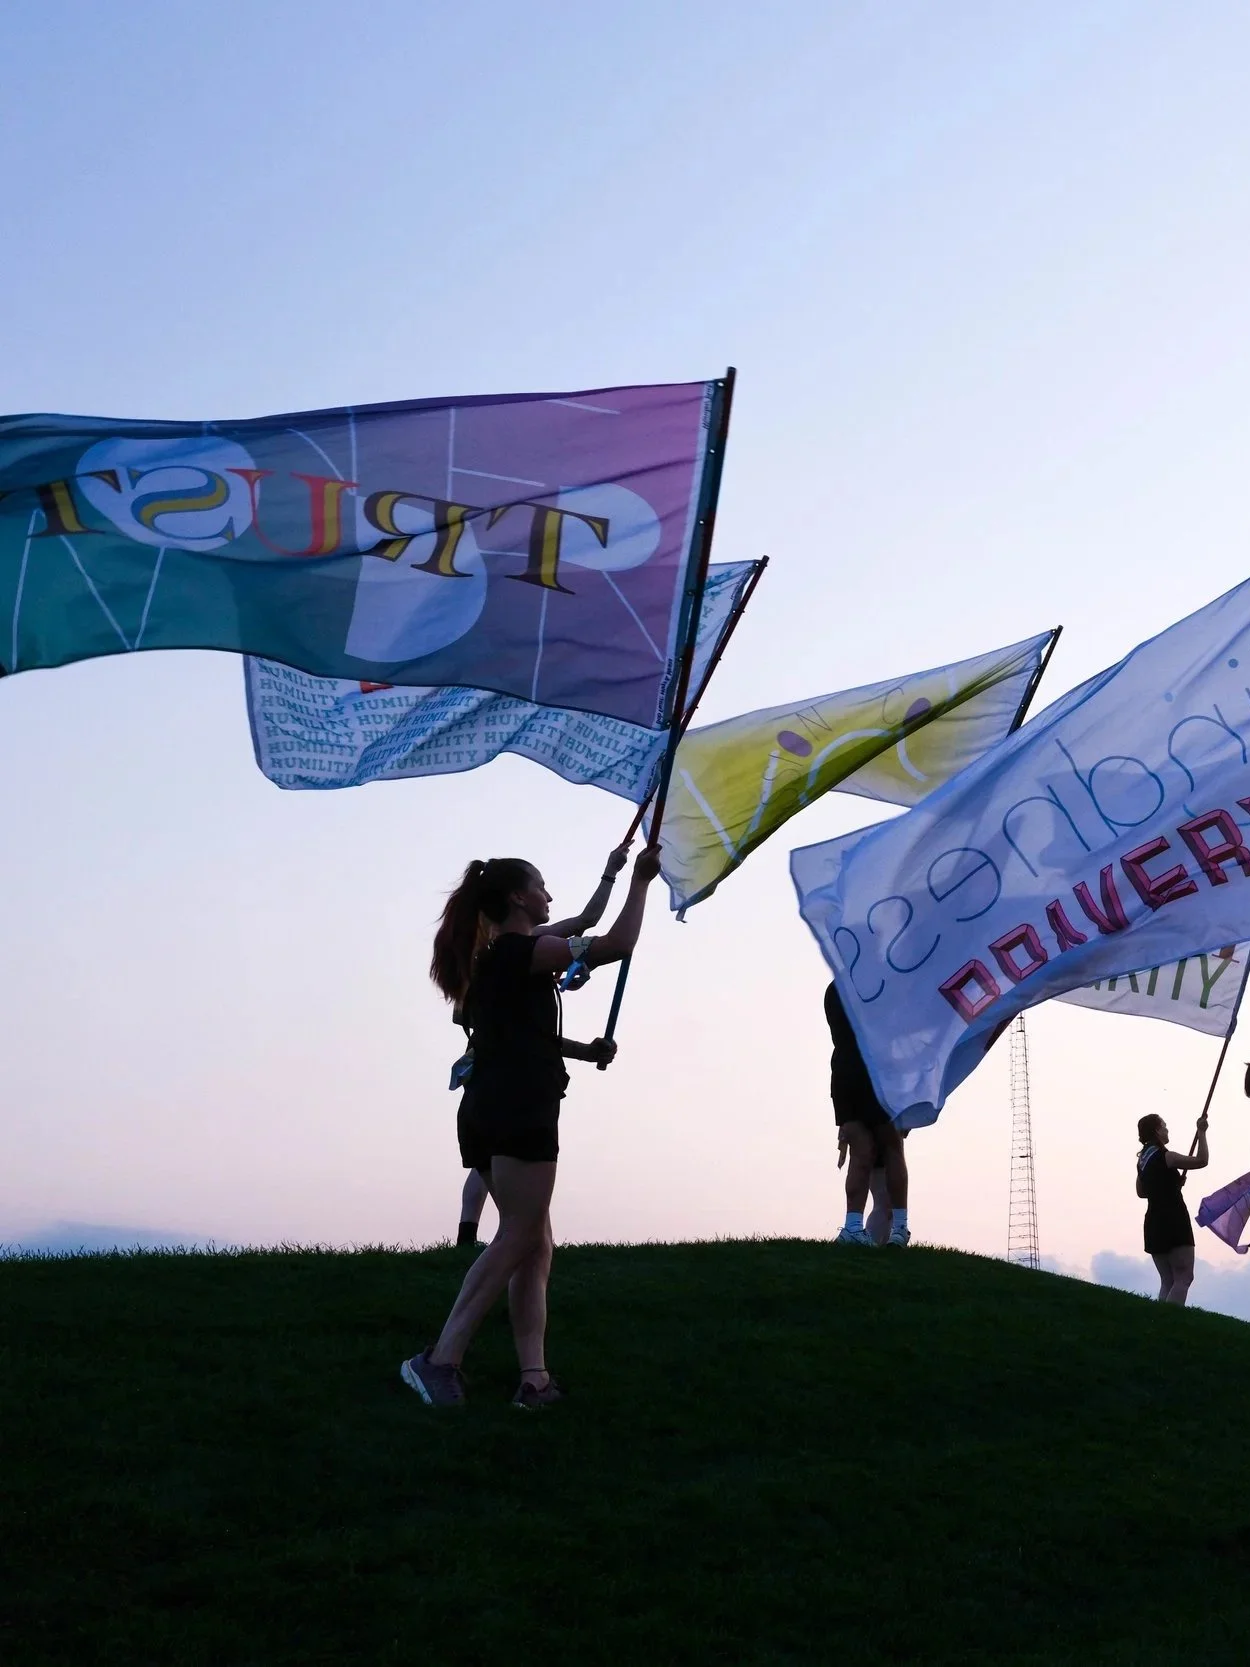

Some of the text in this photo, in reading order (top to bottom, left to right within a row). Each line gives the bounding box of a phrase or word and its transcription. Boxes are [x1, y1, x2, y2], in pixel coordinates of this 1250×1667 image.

[258, 660, 338, 690] HUMILITY
[260, 678, 341, 705] HUMILITY
[260, 695, 345, 718] HUMILITY
[352, 695, 421, 712] HUMIL
[263, 711, 350, 731] HUMILITY
[485, 711, 574, 728] HUMLITY
[484, 723, 566, 744] HUILITY
[268, 741, 358, 757] HUMILITY
[574, 721, 651, 761] HUMILITY
[271, 757, 354, 774] HUMILITY
[564, 736, 645, 776] HUMILTY
[557, 753, 638, 790] HUMITY
